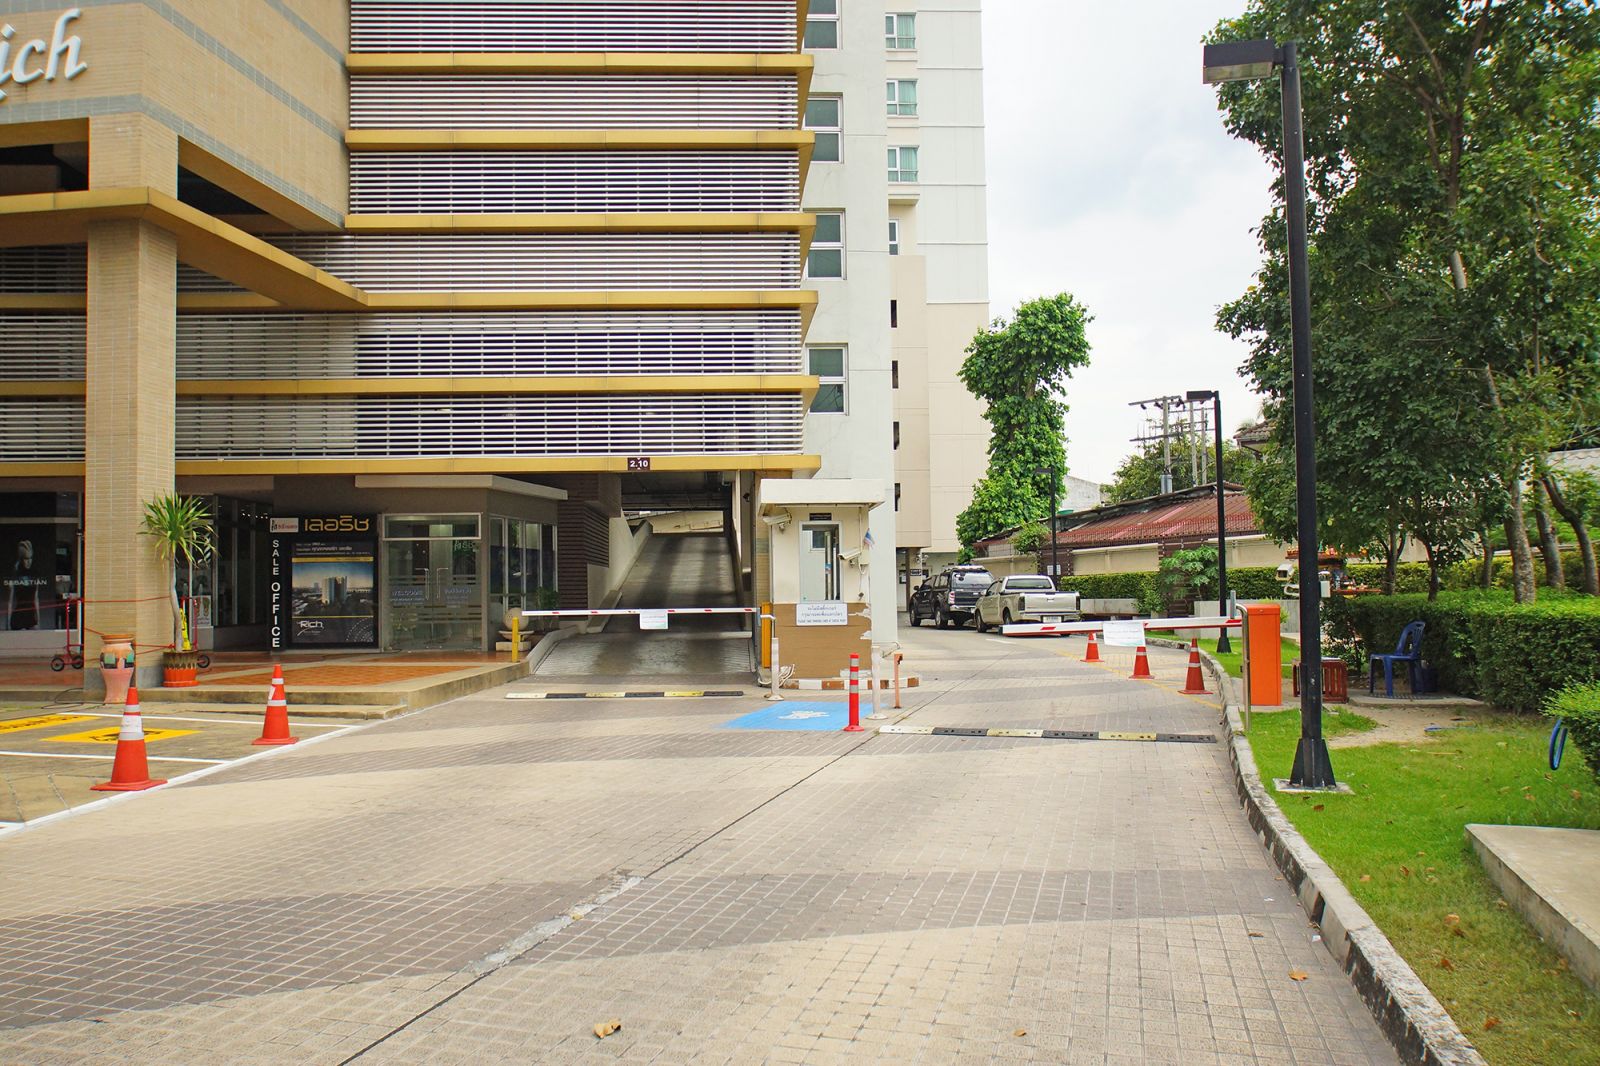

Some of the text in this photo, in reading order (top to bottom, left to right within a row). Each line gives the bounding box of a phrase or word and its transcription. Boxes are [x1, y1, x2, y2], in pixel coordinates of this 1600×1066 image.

[0, 8, 87, 86] ich
[629, 459, 649, 468] 2.10
[271, 539, 281, 648] SALE OFFICE
